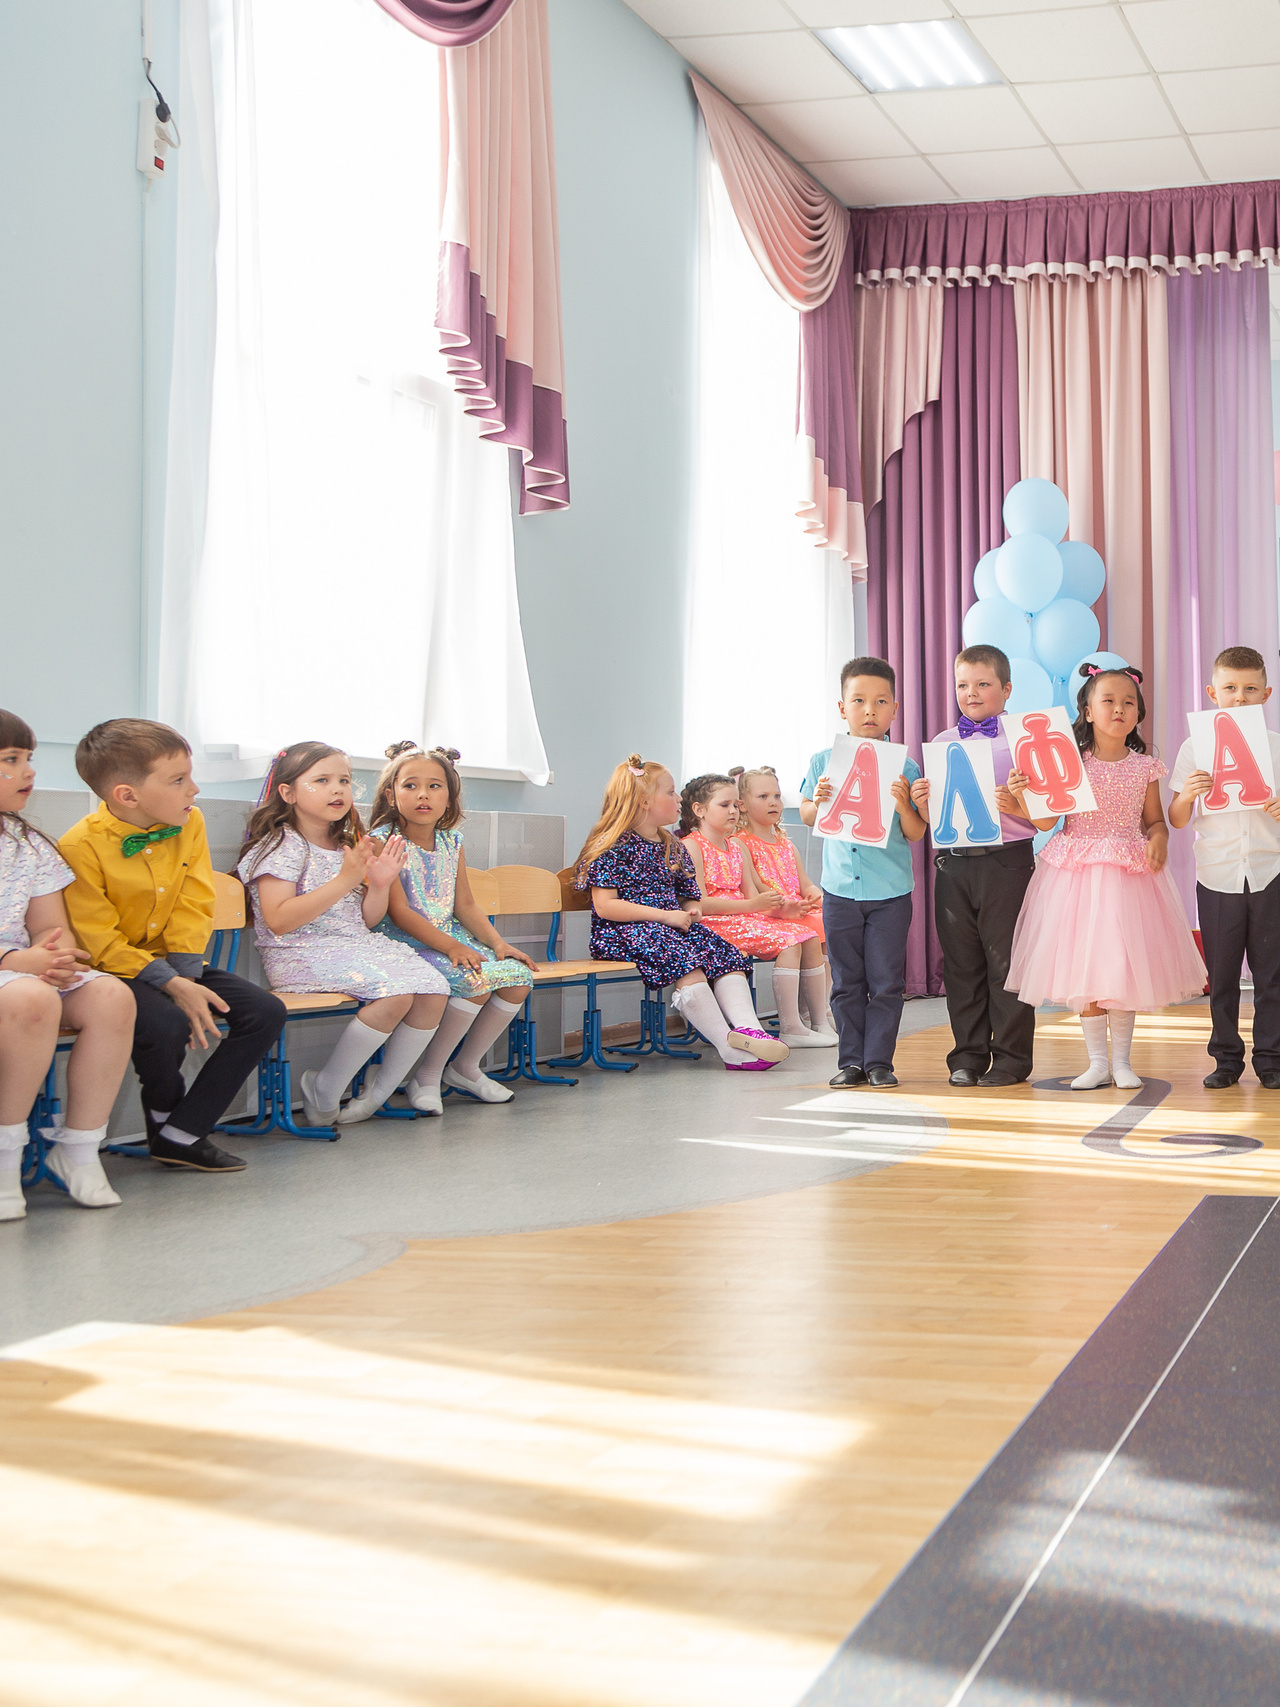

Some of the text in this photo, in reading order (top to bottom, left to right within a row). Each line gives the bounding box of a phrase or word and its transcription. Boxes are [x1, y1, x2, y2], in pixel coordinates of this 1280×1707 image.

[818, 741, 887, 843] А
[1014, 712, 1083, 813] Ф
[1204, 712, 1273, 811] А
